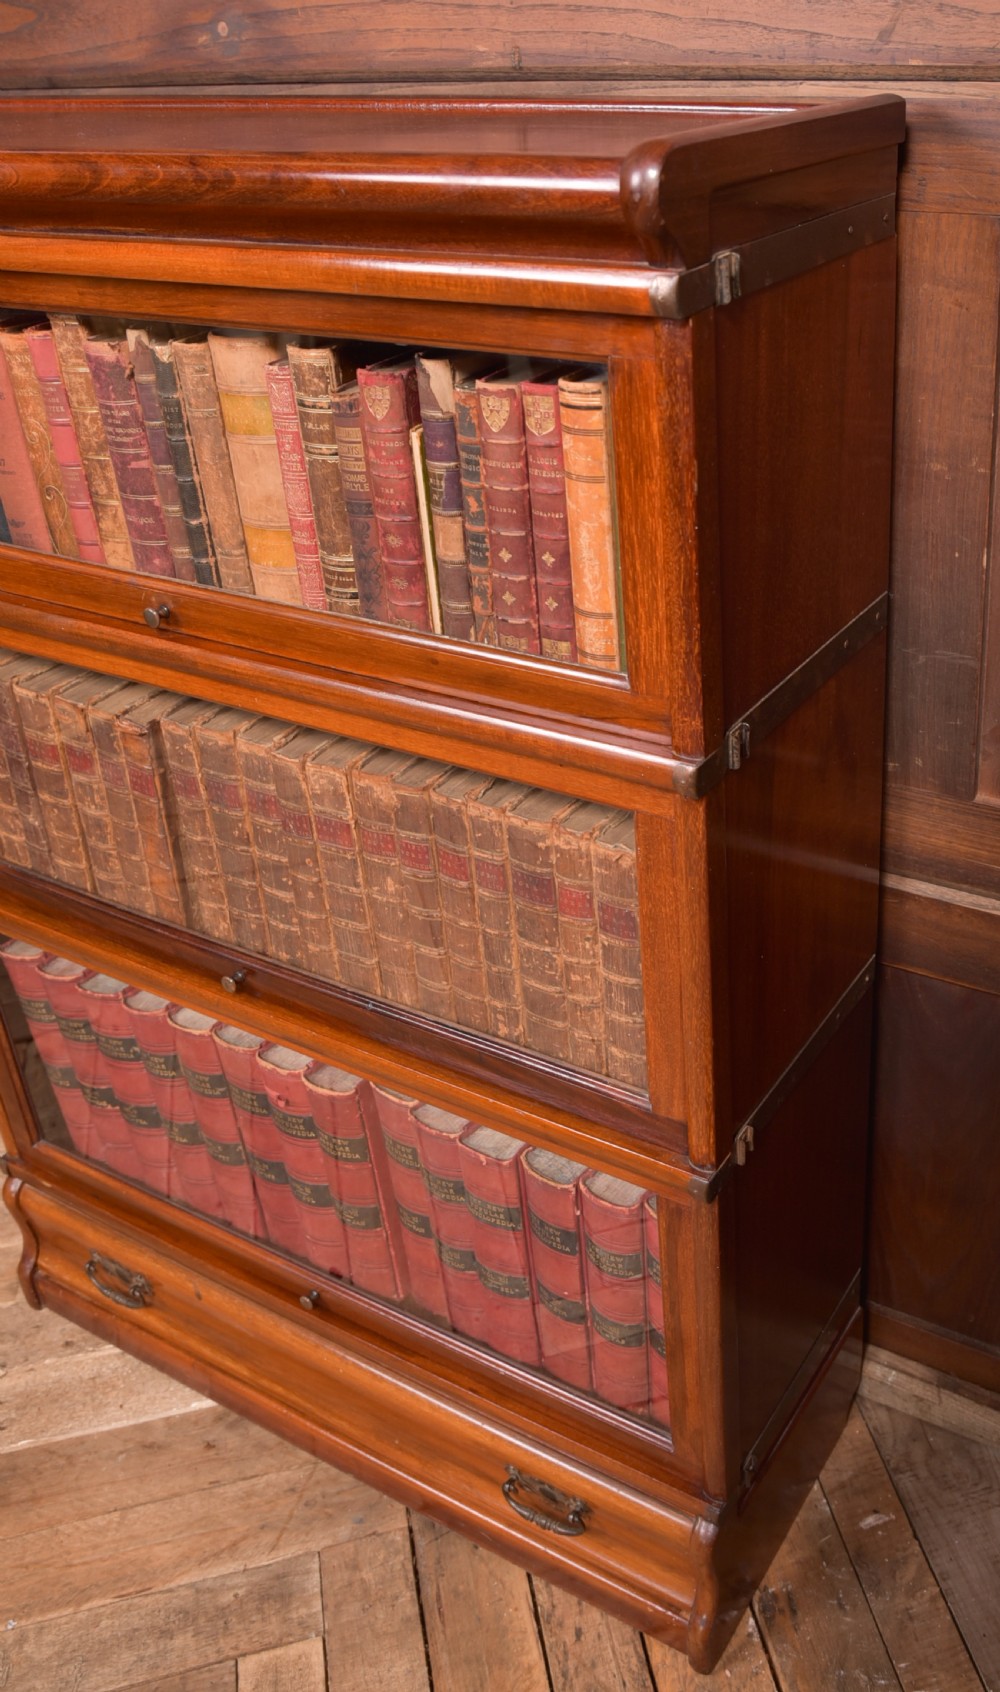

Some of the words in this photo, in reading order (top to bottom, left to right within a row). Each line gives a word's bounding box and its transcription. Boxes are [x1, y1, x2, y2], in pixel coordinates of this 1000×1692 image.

[489, 504, 517, 514] BELINDA
[287, 1116, 304, 1124] NEW
[486, 1203, 505, 1213] NEW
